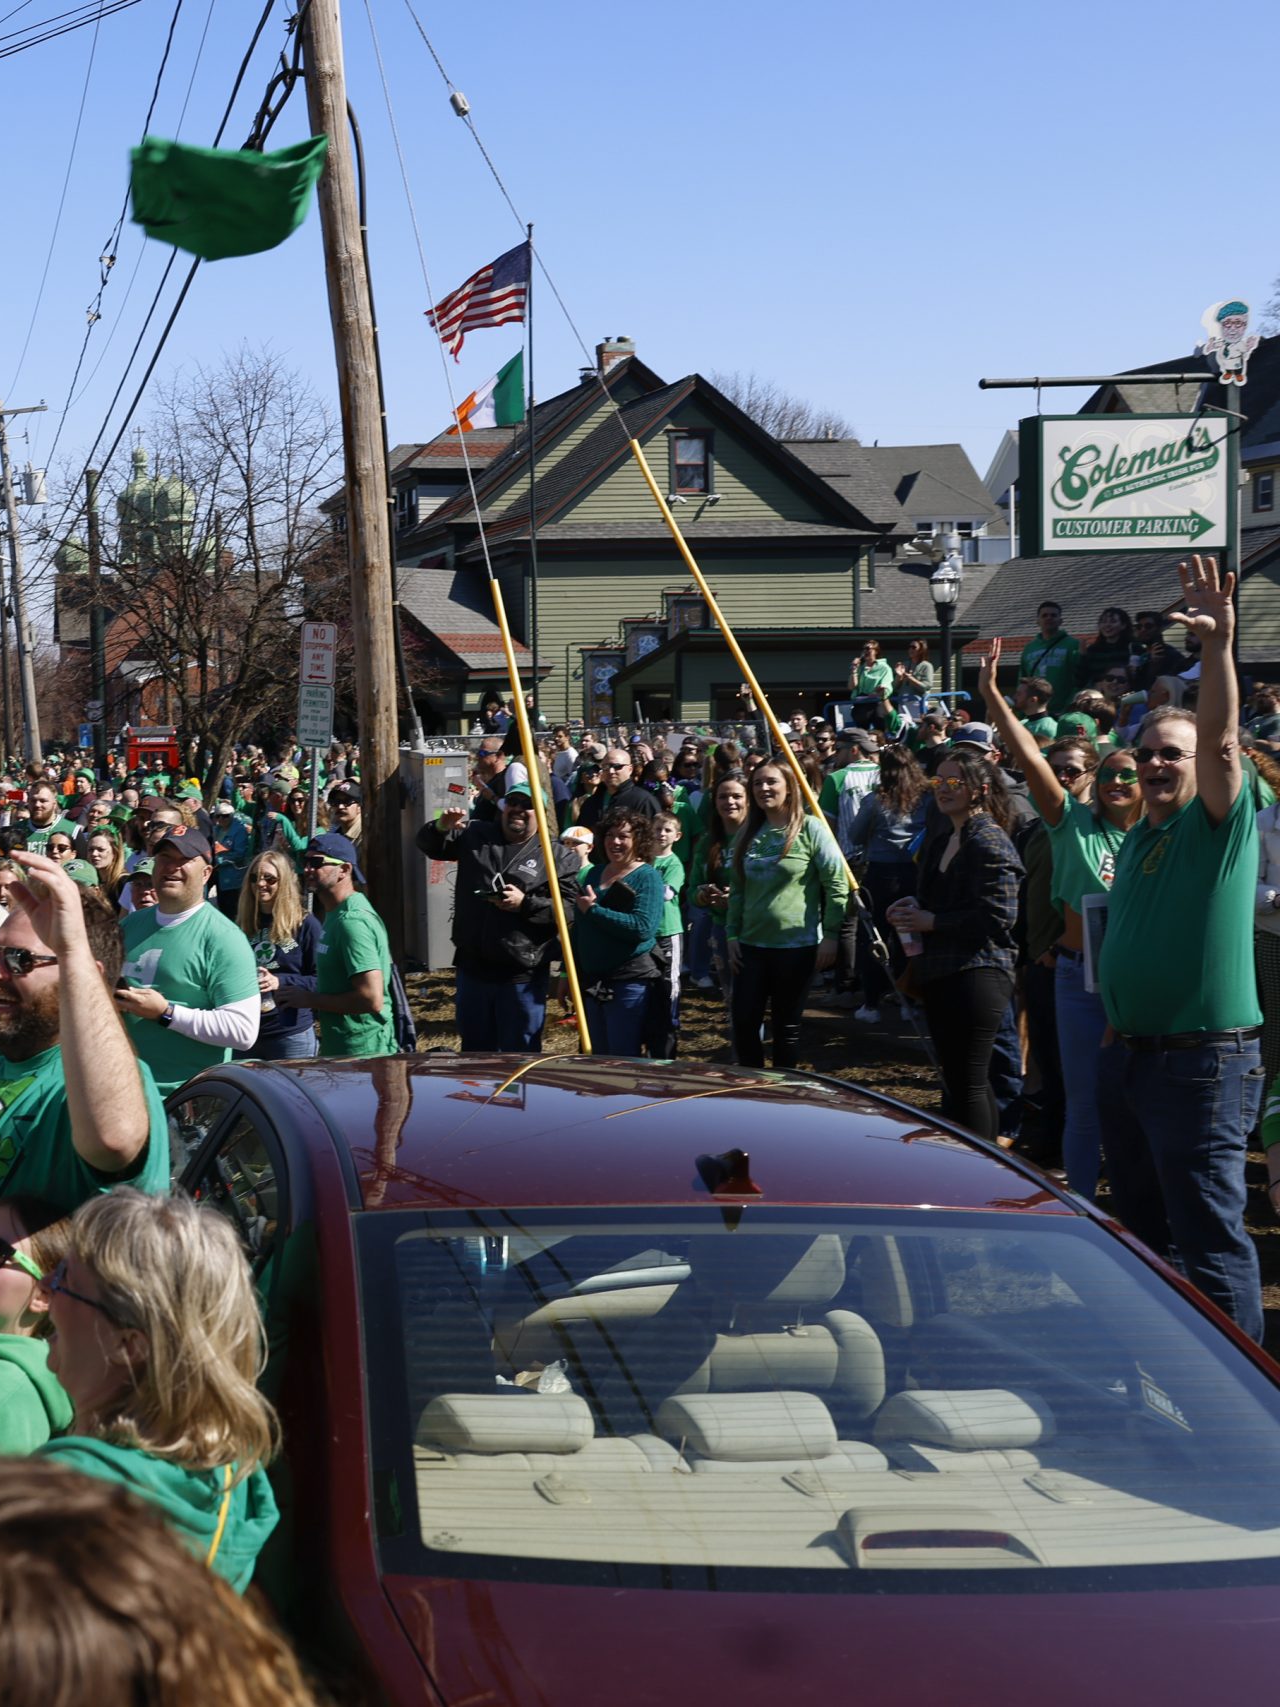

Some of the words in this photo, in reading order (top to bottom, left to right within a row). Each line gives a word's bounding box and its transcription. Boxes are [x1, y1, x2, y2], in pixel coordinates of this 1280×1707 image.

[1051, 427, 1214, 511] Coleman's
[1056, 519, 1131, 535] CUSTOMER
[1135, 518, 1199, 534] PARKING
[312, 628, 325, 639] NO
[305, 642, 332, 651] STOPPING
[311, 663, 325, 672] TIME
